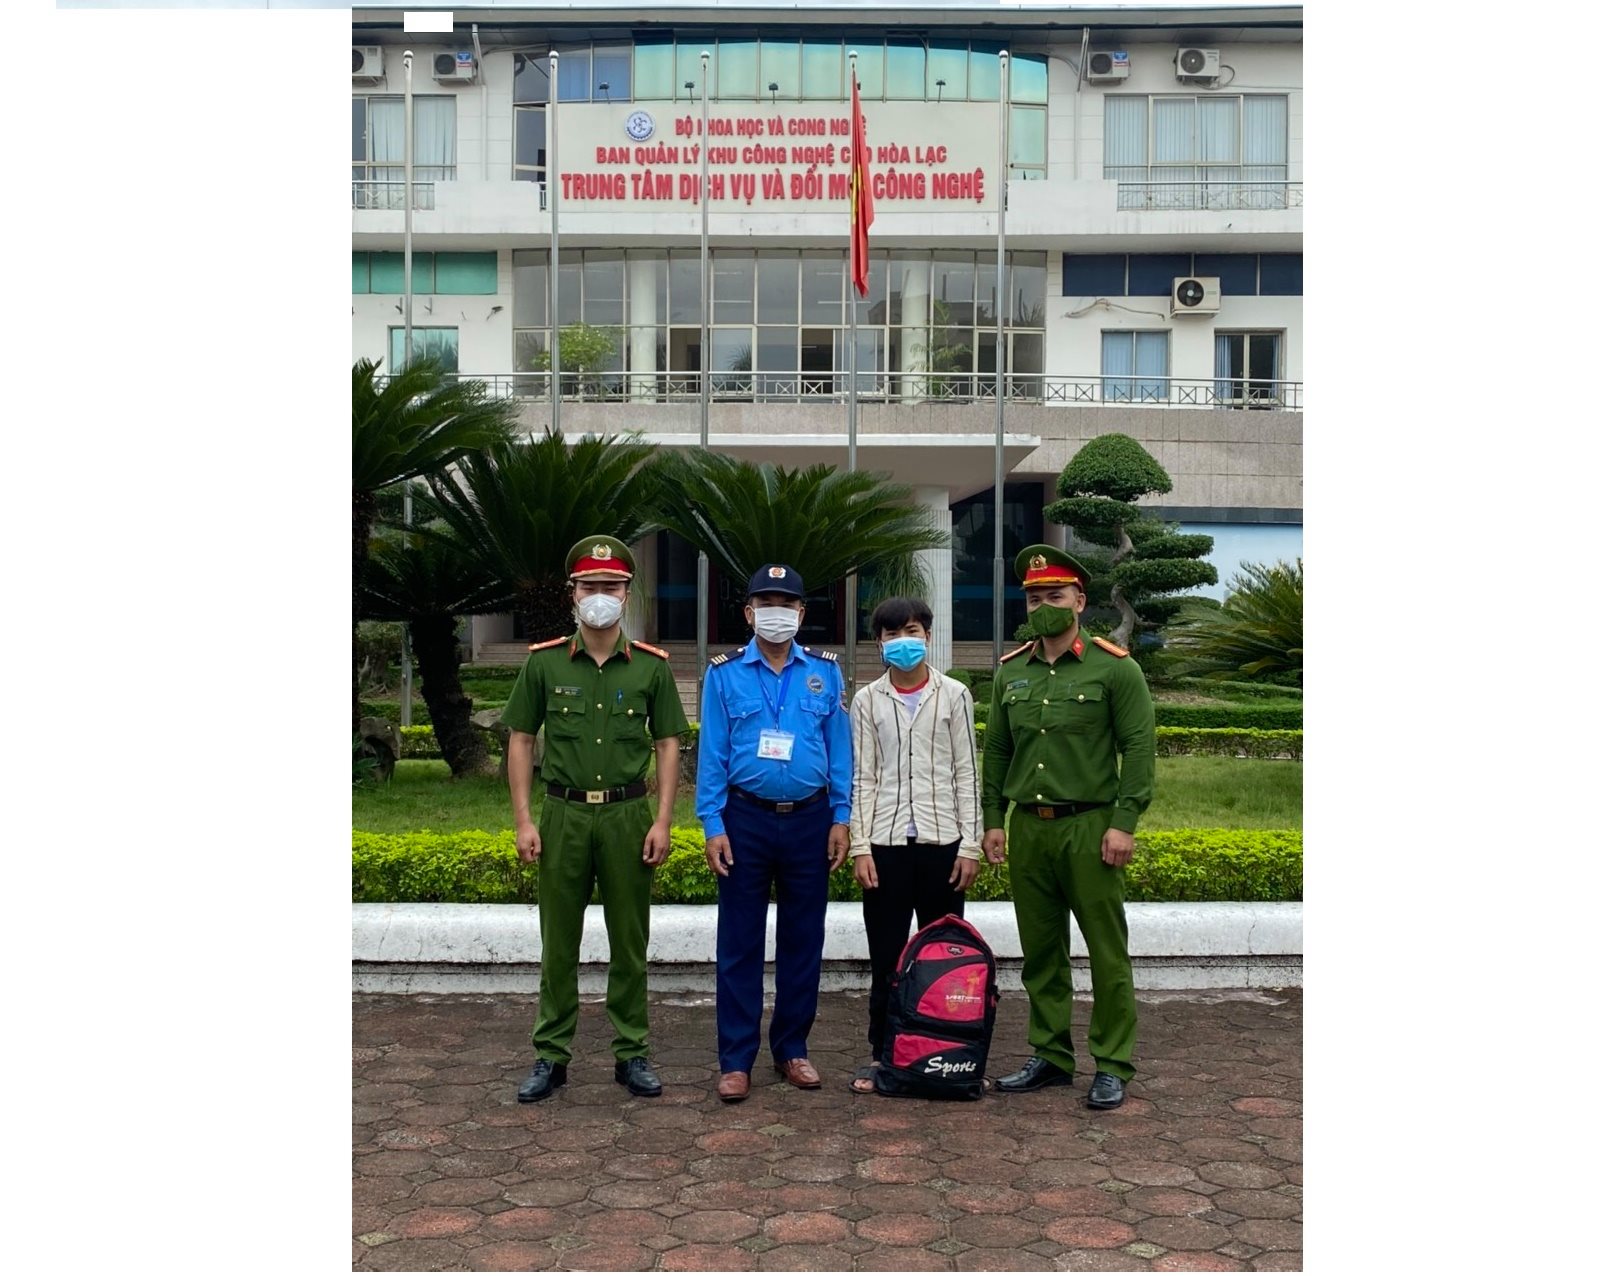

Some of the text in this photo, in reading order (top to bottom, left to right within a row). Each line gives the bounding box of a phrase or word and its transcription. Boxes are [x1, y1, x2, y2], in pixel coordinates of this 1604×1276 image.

[675, 115, 693, 139] BỘ
[736, 118, 763, 139] HỌC
[768, 115, 785, 136] VÀ
[829, 115, 867, 136] NG
[596, 146, 630, 164] BAN
[634, 141, 678, 166] QUẢN
[683, 143, 701, 164] LÝ
[742, 143, 786, 164] CÔNG
[791, 143, 835, 167] NGHỆ
[877, 142, 911, 164] HÒA
[915, 146, 947, 167] LẠC
[561, 173, 626, 200] TRUNG
[631, 168, 673, 200] TÂM
[730, 174, 756, 205] VỤ
[761, 168, 785, 200] VÀ
[790, 163, 823, 200] ĐỔI
[872, 167, 926, 200] CÔNG
[931, 167, 985, 204] NGHỆ
[924, 1056, 977, 1077] Sports
